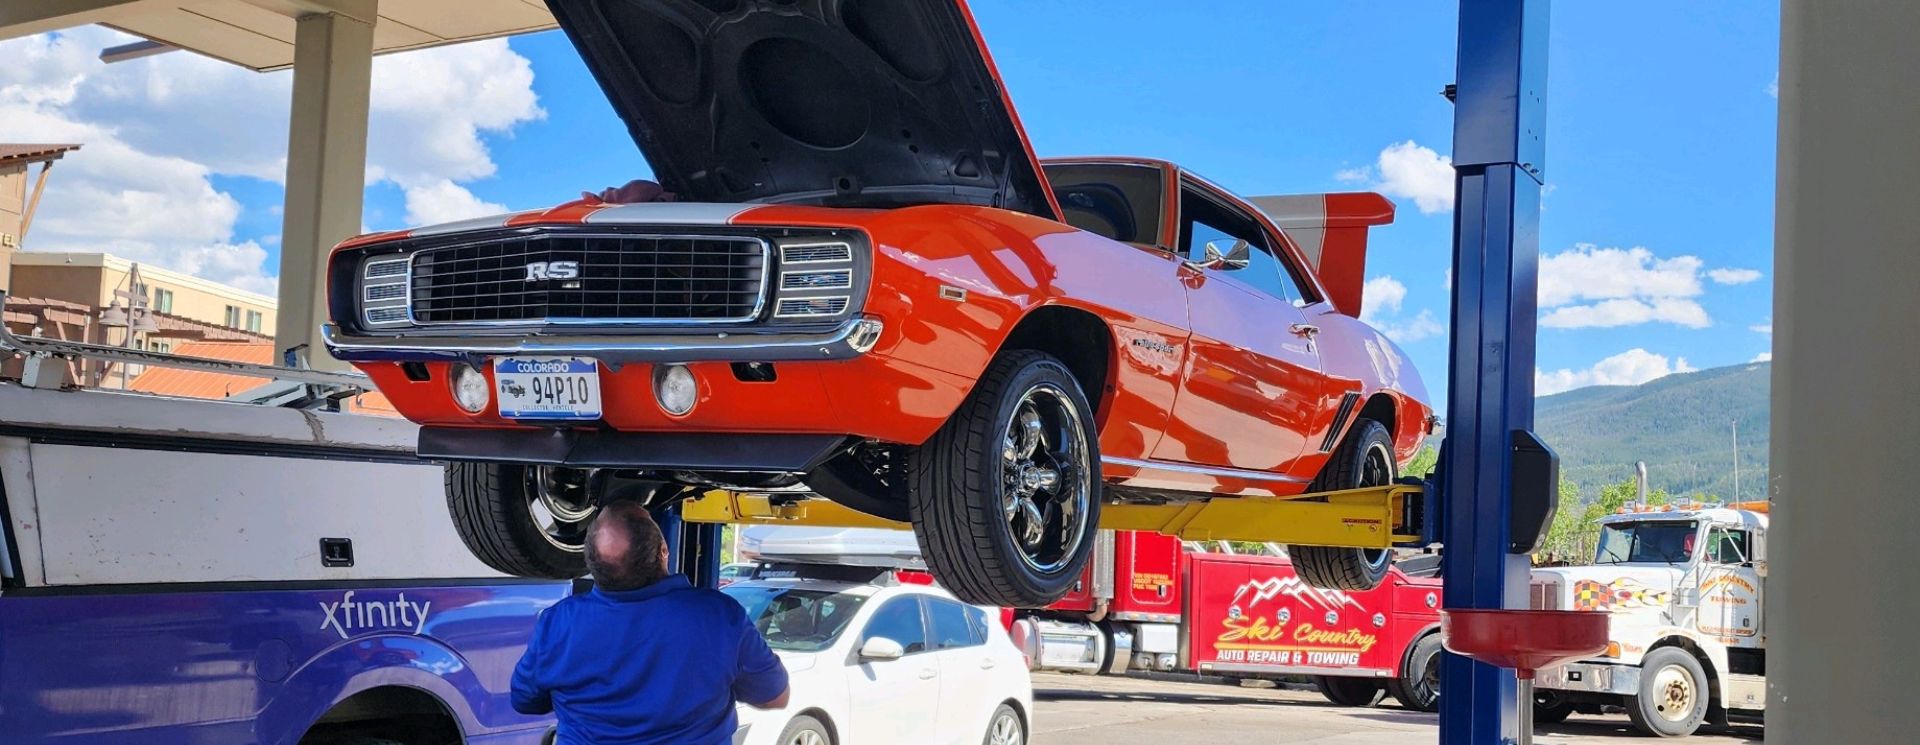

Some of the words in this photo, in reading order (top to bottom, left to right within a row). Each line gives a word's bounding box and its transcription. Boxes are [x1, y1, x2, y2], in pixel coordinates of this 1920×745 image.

[525, 261, 579, 282] RS
[517, 362, 569, 373] COLORADO
[532, 376, 589, 405] 94P10
[319, 590, 431, 639] xfinity
[1218, 615, 1287, 641] Ski
[1293, 623, 1377, 652] Country
[1216, 650, 1245, 661] AUTO
[1247, 651, 1289, 663] REPAIR
[1306, 652, 1360, 665] TOWING
